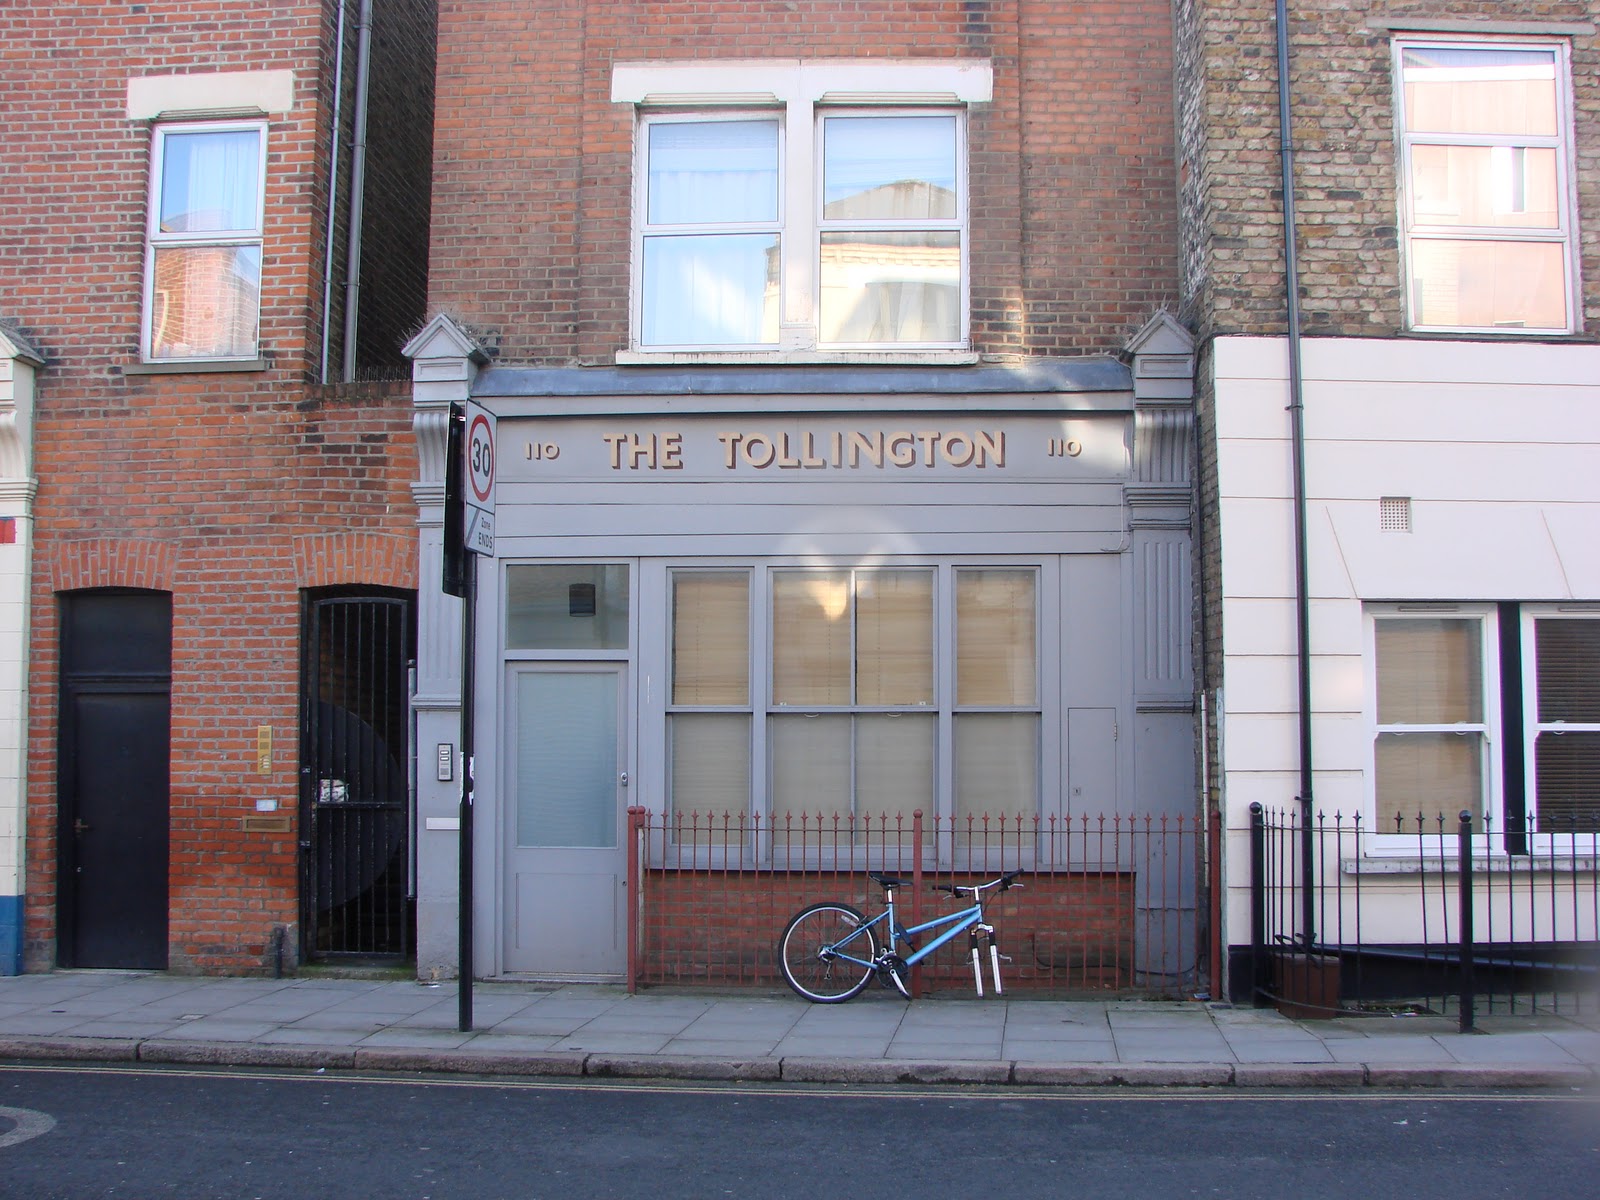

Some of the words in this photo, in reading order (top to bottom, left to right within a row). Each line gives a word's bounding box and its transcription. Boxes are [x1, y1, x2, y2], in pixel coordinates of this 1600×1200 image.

[473, 438, 491, 478] 30
[524, 441, 560, 460] 110
[603, 433, 683, 470] THE
[718, 431, 1005, 469] TOLLINGTON
[1048, 437, 1082, 457] 110
[481, 517, 491, 531] Zone
[478, 532, 493, 549] ENDS
